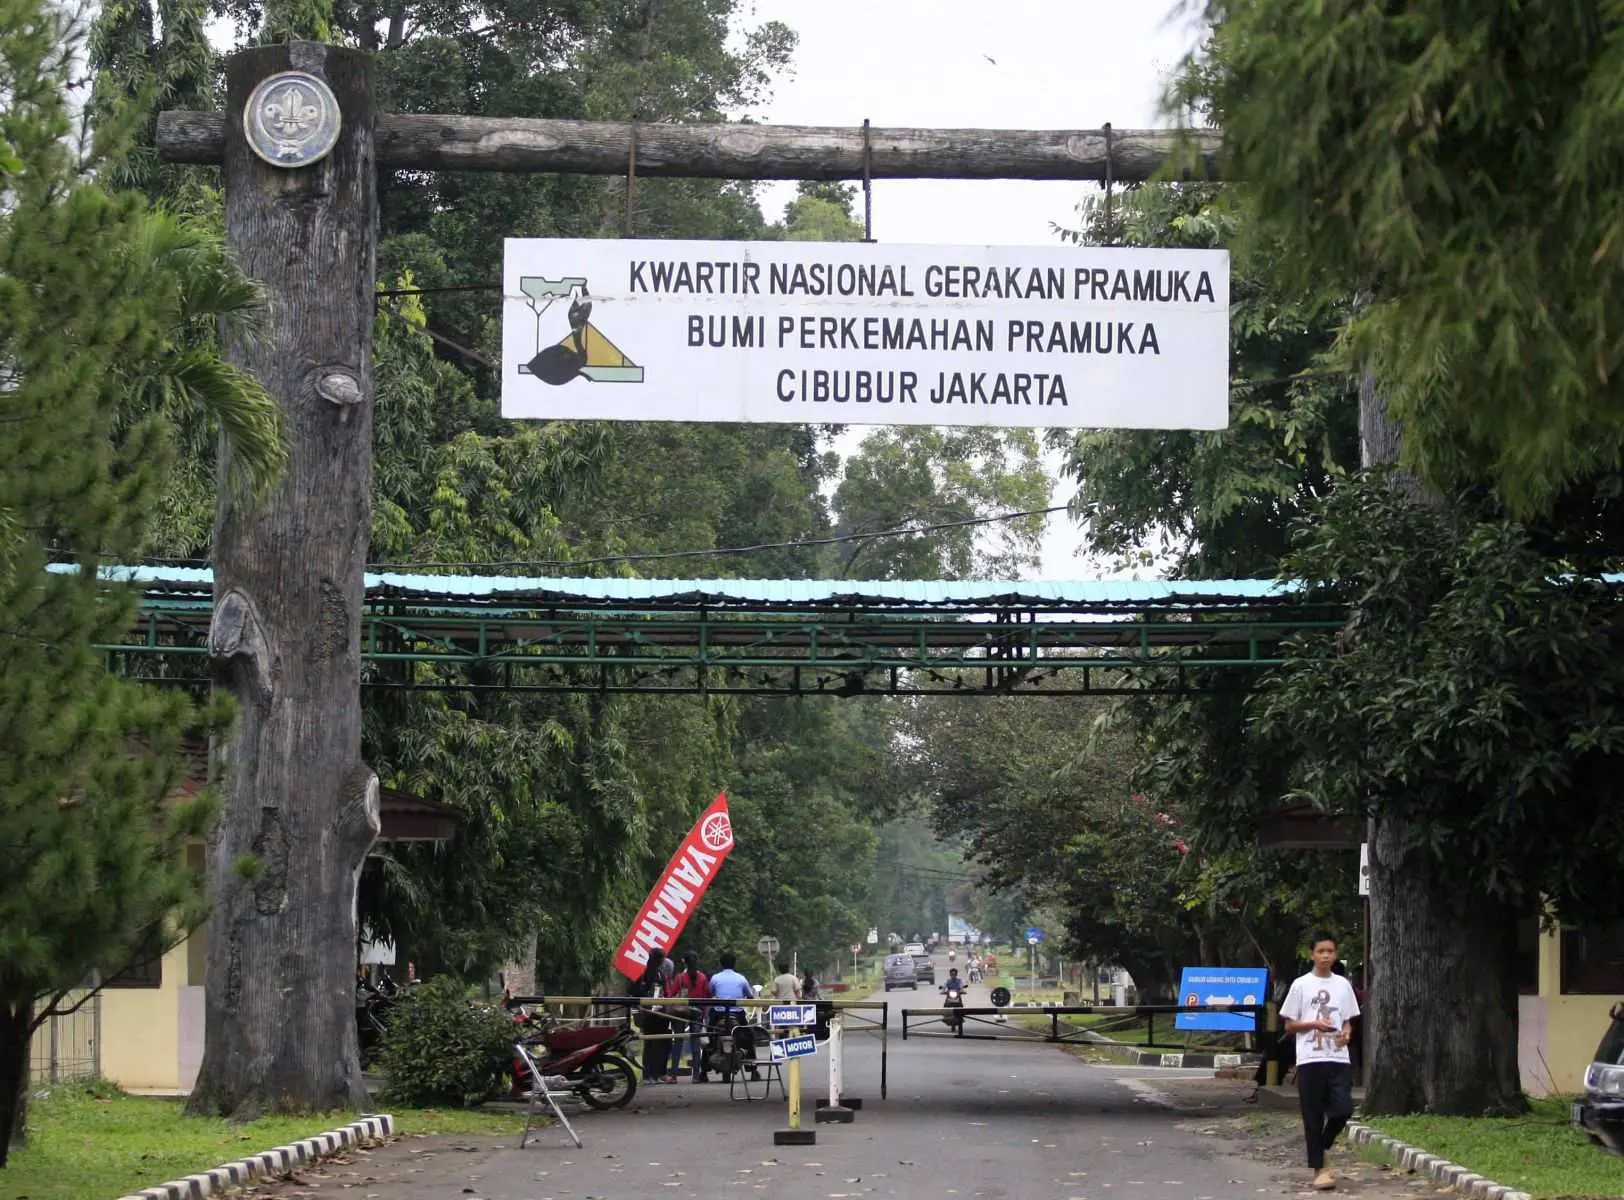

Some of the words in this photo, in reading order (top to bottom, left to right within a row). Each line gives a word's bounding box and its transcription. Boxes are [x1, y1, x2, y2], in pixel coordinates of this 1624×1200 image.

[630, 261, 760, 295] KWARTIR
[770, 263, 914, 297] NASIONAL
[925, 265, 1065, 299] GERAKAN
[1074, 268, 1215, 303] PRAMUKA
[688, 315, 764, 348] BUMI
[778, 316, 993, 352] PERKEMAHAN
[1008, 320, 1160, 355] PRAMUKA
[776, 369, 918, 403] CIBUBUR
[930, 372, 1068, 406] JAKARTA
[623, 844, 717, 966] YAMAHA
[773, 1010, 800, 1020] MOBIL
[787, 1040, 814, 1052] MOTOR
